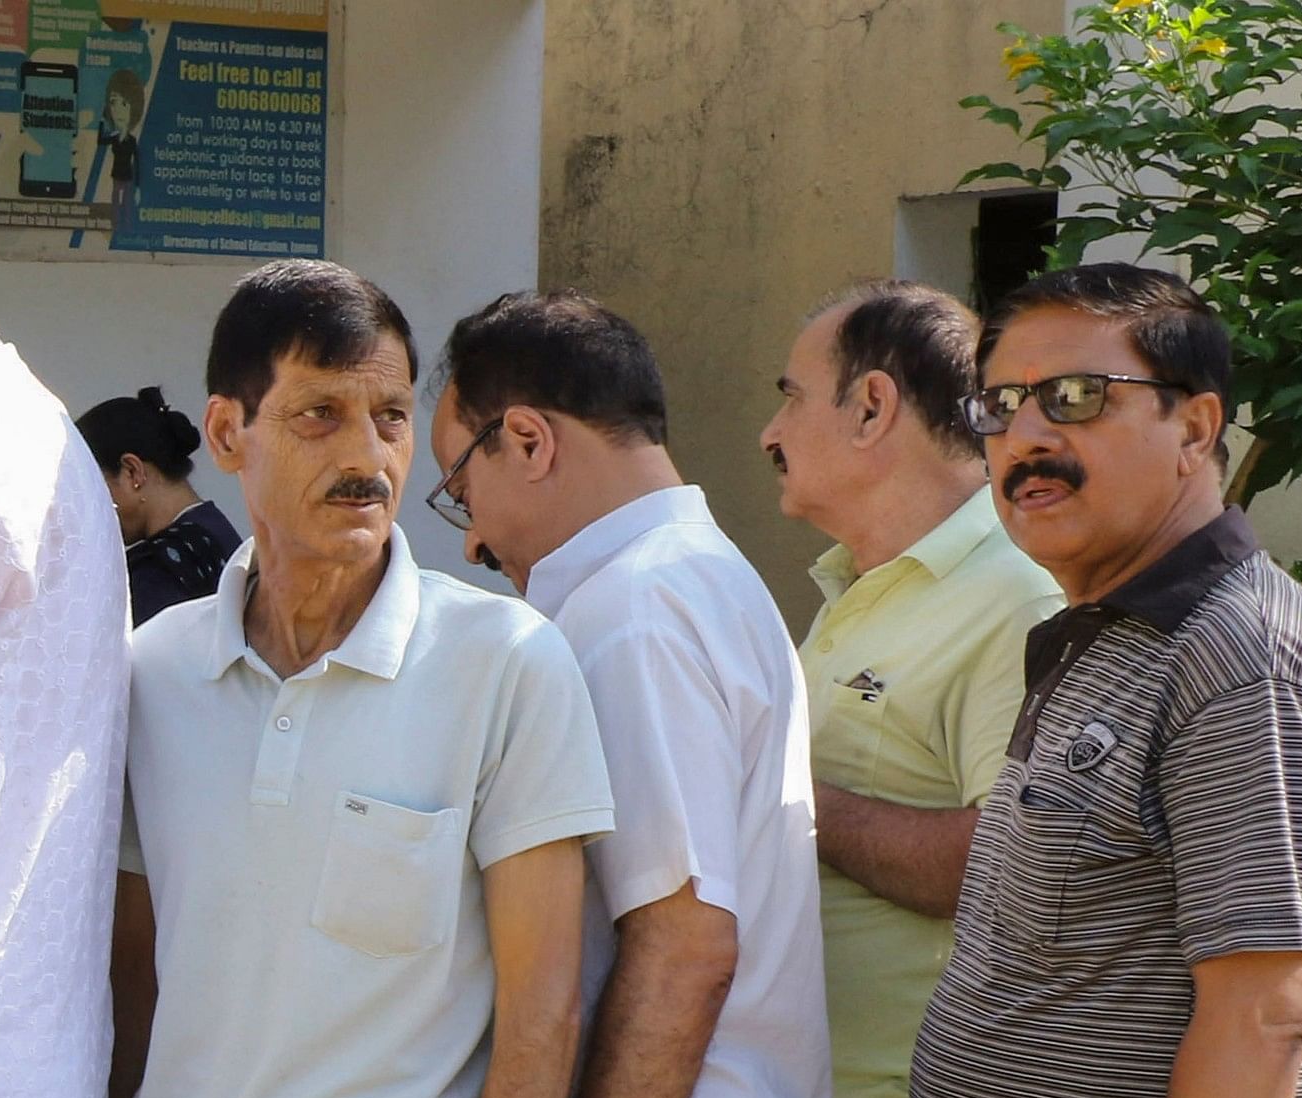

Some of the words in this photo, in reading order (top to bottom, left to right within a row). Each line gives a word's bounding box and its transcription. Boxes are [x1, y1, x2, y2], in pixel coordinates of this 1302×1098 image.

[180, 59, 213, 83] Feel
[217, 62, 250, 84] free
[254, 65, 271, 87] to
[273, 66, 304, 88] call
[306, 69, 322, 89] at
[217, 88, 321, 115] 6006800068
[177, 113, 203, 129] from
[211, 115, 240, 131] 10:00
[242, 118, 262, 132] AM
[265, 119, 276, 133] to
[279, 120, 302, 135] 4:30
[305, 121, 322, 135] PM
[167, 133, 182, 144] on
[185, 132, 200, 145] all
[202, 134, 247, 151] working
[250, 136, 278, 151] days
[281, 138, 292, 150] to
[296, 138, 322, 152] seek
[154, 147, 216, 165] telephonic
[219, 151, 275, 168] guidance
[278, 156, 290, 167] or
[292, 155, 322, 169] book
[154, 165, 228, 181] appointment
[231, 168, 246, 182] for
[248, 170, 275, 184] face
[281, 171, 292, 184] to
[295, 171, 322, 186] face
[166, 184, 233, 201] counselling
[235, 190, 247, 200] or
[250, 188, 277, 201] write
[280, 189, 291, 202] to
[294, 192, 307, 203] us
[309, 191, 322, 203] at
